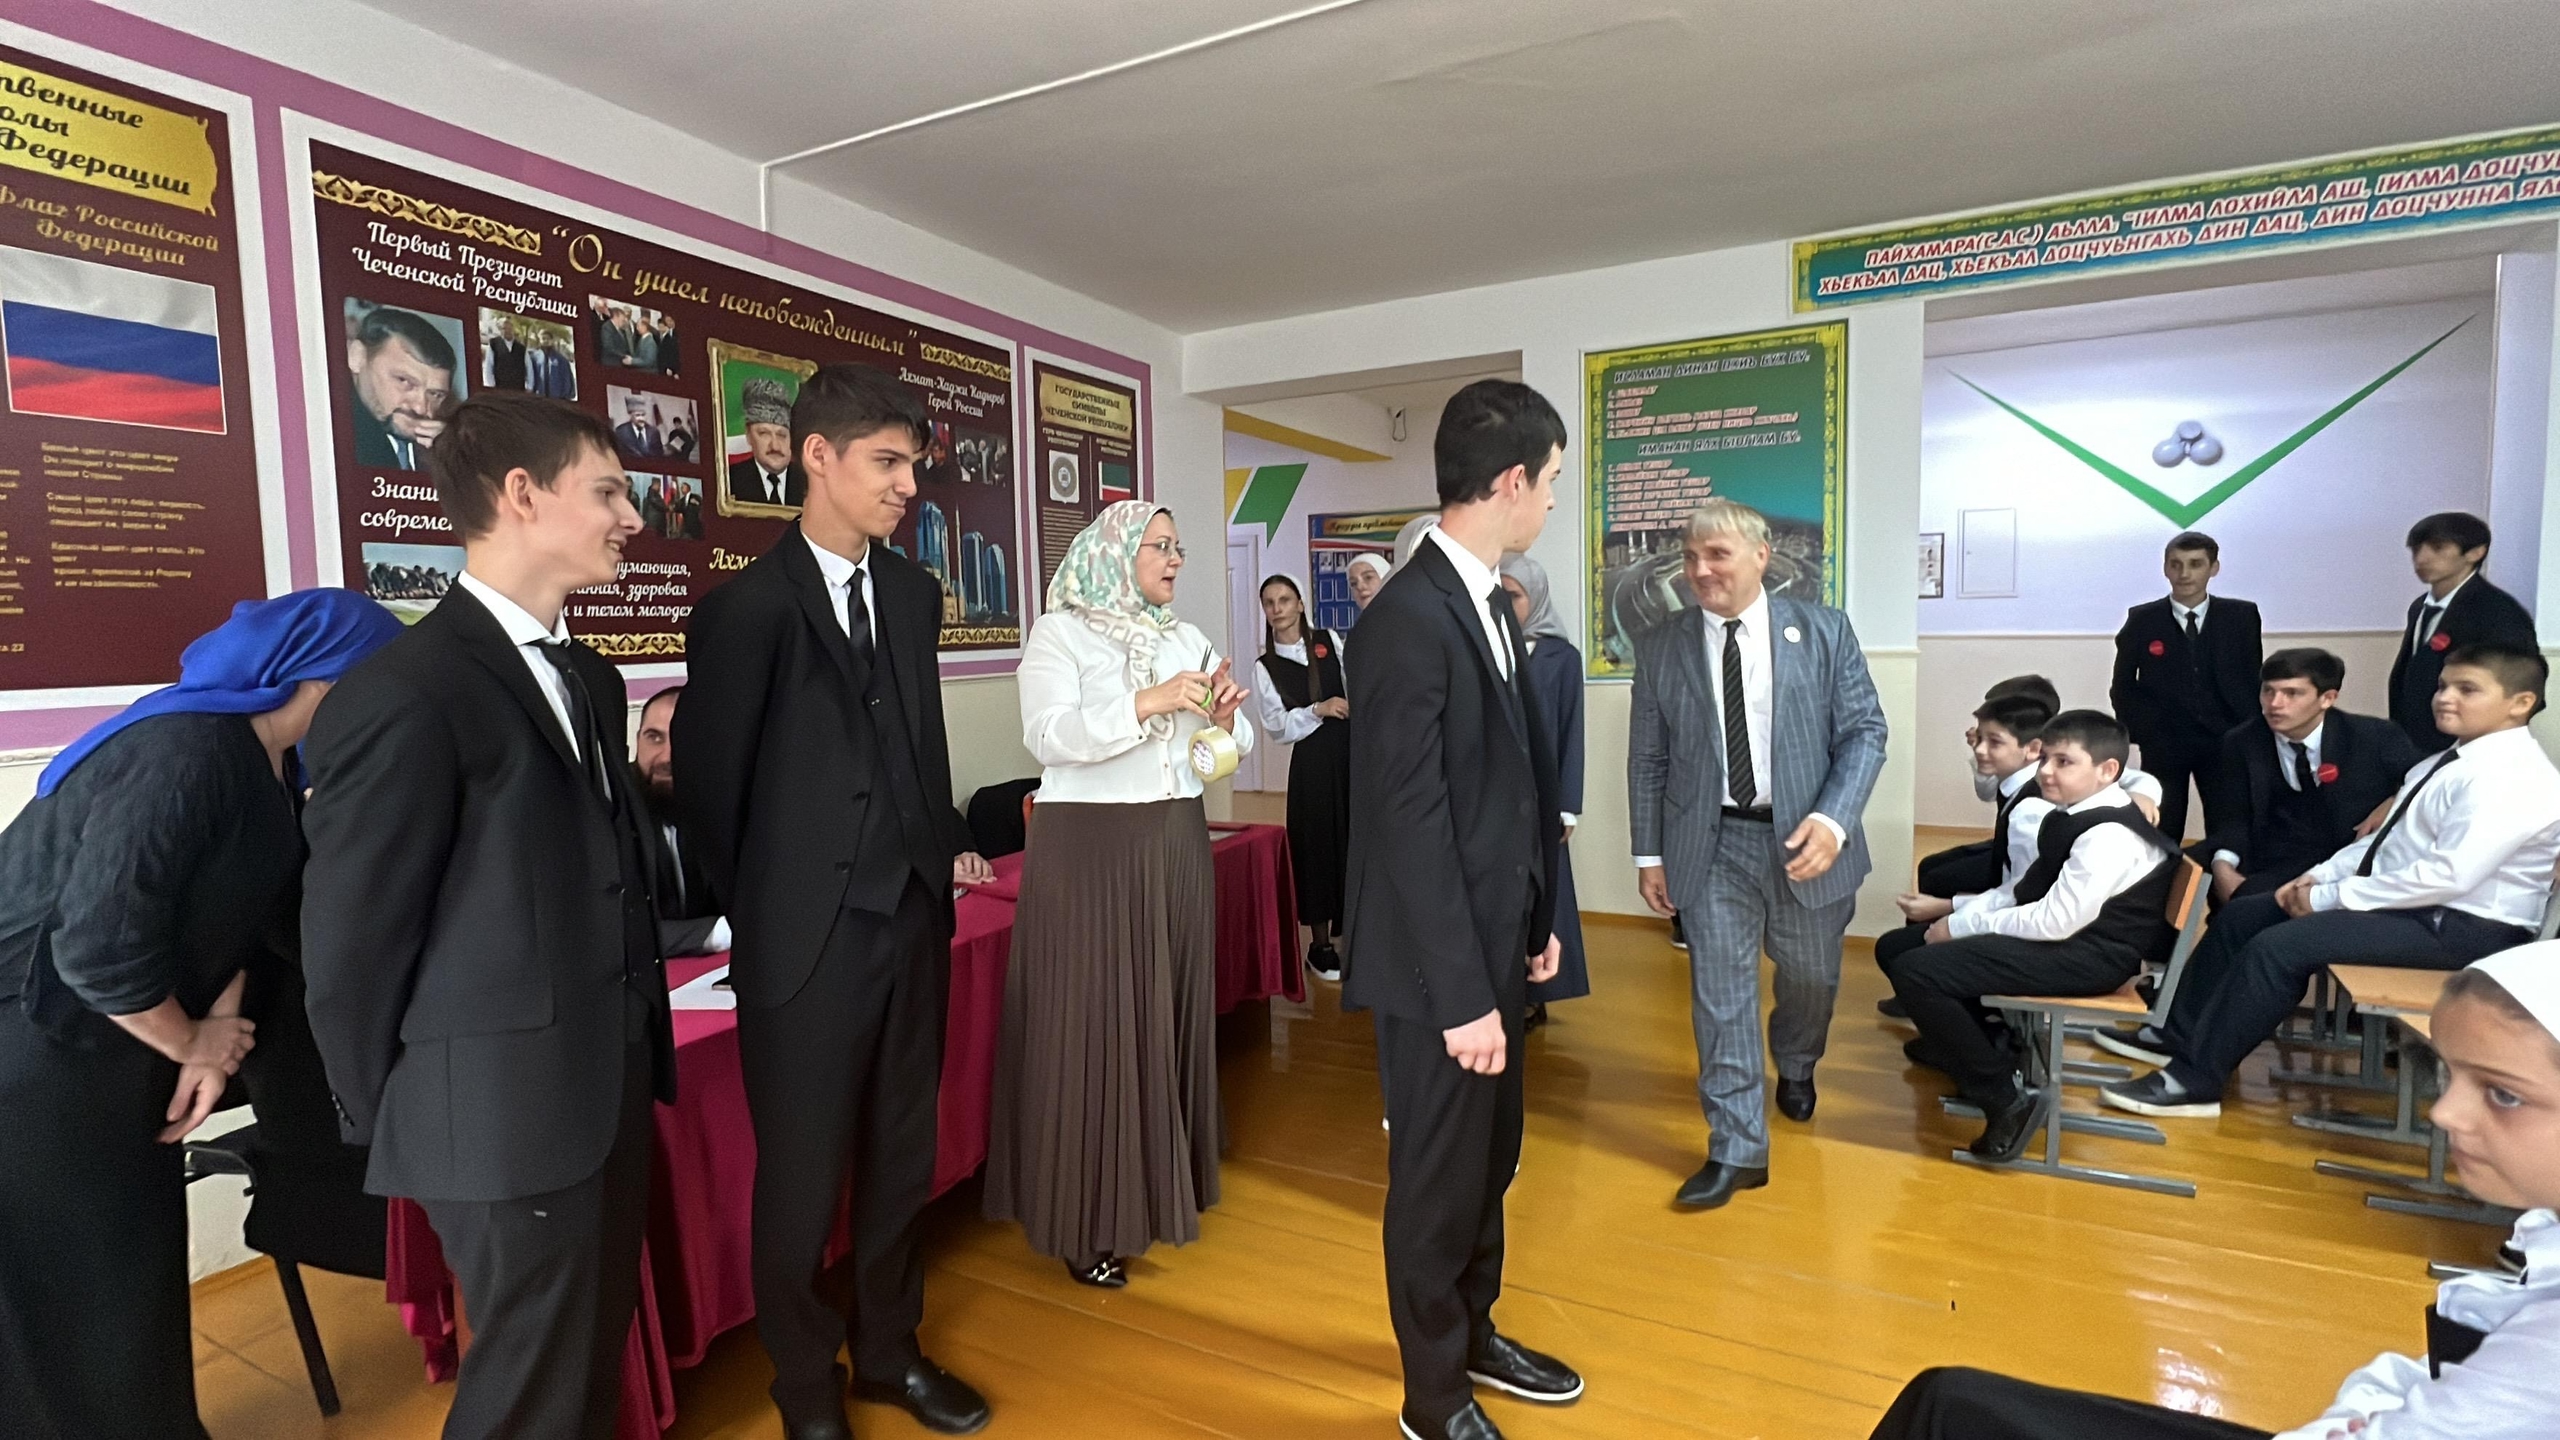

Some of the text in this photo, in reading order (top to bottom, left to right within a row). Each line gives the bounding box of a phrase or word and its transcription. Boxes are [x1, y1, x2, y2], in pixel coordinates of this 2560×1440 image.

[0, 126, 191, 195] Федерации
[2208, 185, 2317, 219] ЛОХИЙЛА
[2462, 150, 2560, 182] ДОЦЧУ
[36, 218, 185, 265] Федерации
[75, 204, 219, 251] Российской
[1818, 269, 1899, 295] ХЬЕКЪАЛ
[1951, 250, 2037, 276] ХЬЕКЪАЛ
[2042, 229, 2192, 264] ДОЦЧУЬНГАХЬ
[2195, 219, 2249, 244] ДИН
[2310, 202, 2367, 229] ДИН
[2374, 182, 2513, 220] ДОЦЧУННА
[367, 221, 564, 288] Первый Президент
[352, 247, 578, 318] Чеченской Республики
[633, 267, 709, 303] ушел
[899, 367, 1005, 409] Ахмат-Хаджи Кадыров
[928, 392, 983, 418] Герой России
[371, 476, 440, 502] Знани
[360, 508, 453, 538] совреме
[616, 561, 692, 580] умающая,
[708, 547, 758, 571] Ахм
[573, 605, 583, 617] и
[586, 605, 634, 617] телом
[626, 581, 688, 602] здоровая
